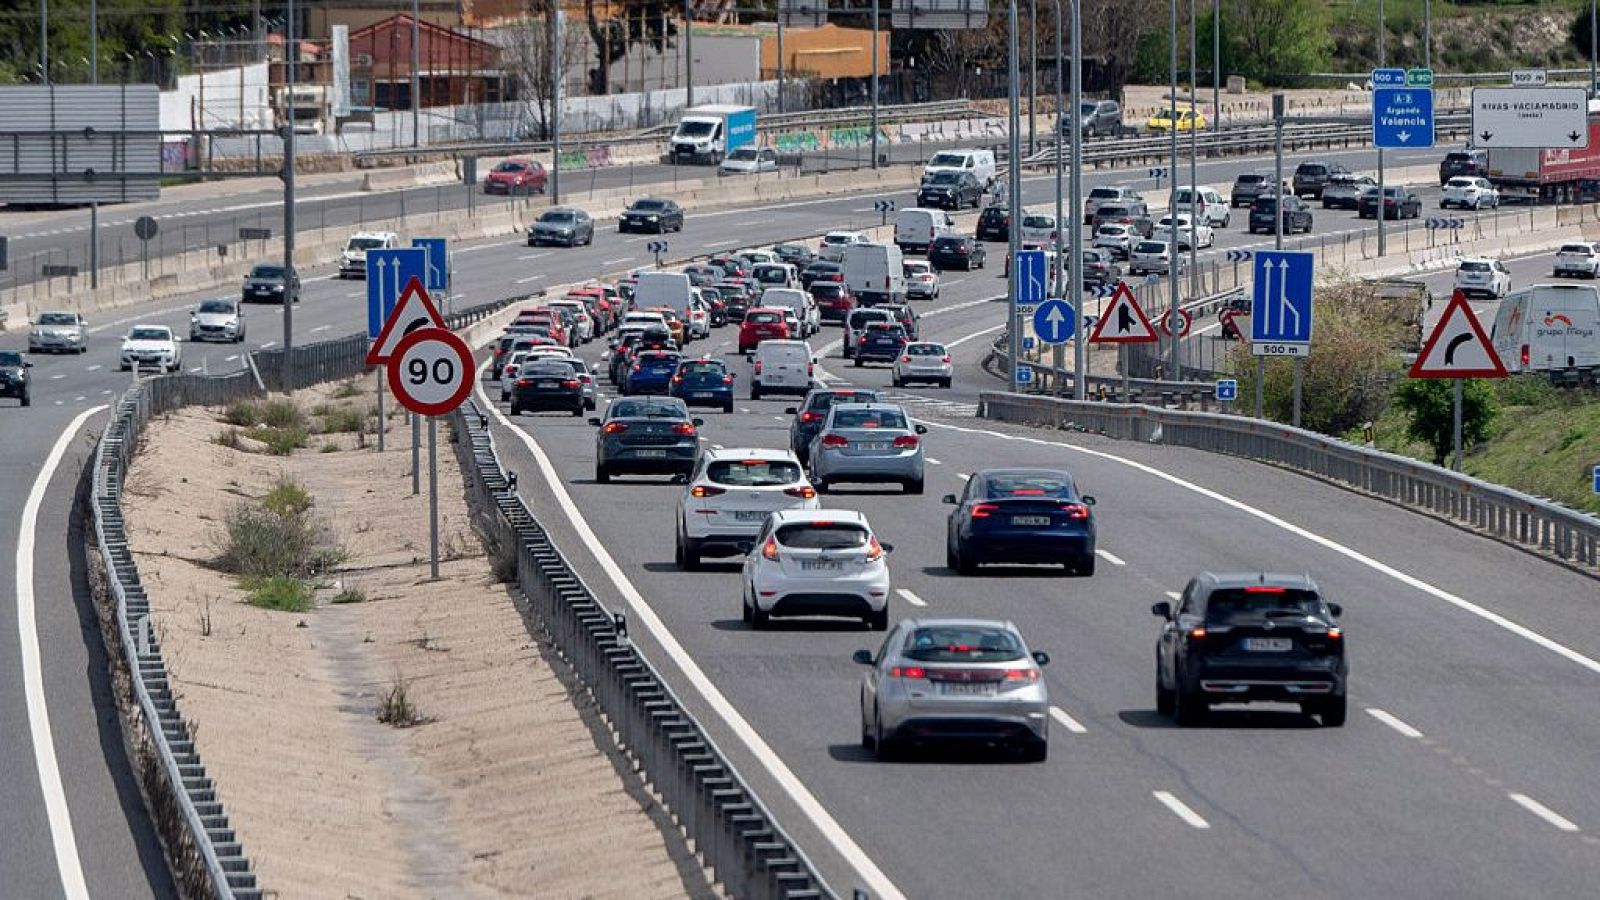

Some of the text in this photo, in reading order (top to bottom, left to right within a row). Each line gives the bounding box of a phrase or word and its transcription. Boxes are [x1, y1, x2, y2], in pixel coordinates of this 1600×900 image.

[1374, 73, 1392, 82] 500
[1514, 73, 1532, 82] 500
[1380, 116, 1426, 126] Valencia
[1537, 328, 1563, 338] grupo
[1263, 344, 1299, 354] 500 m
[408, 357, 454, 385] 90
